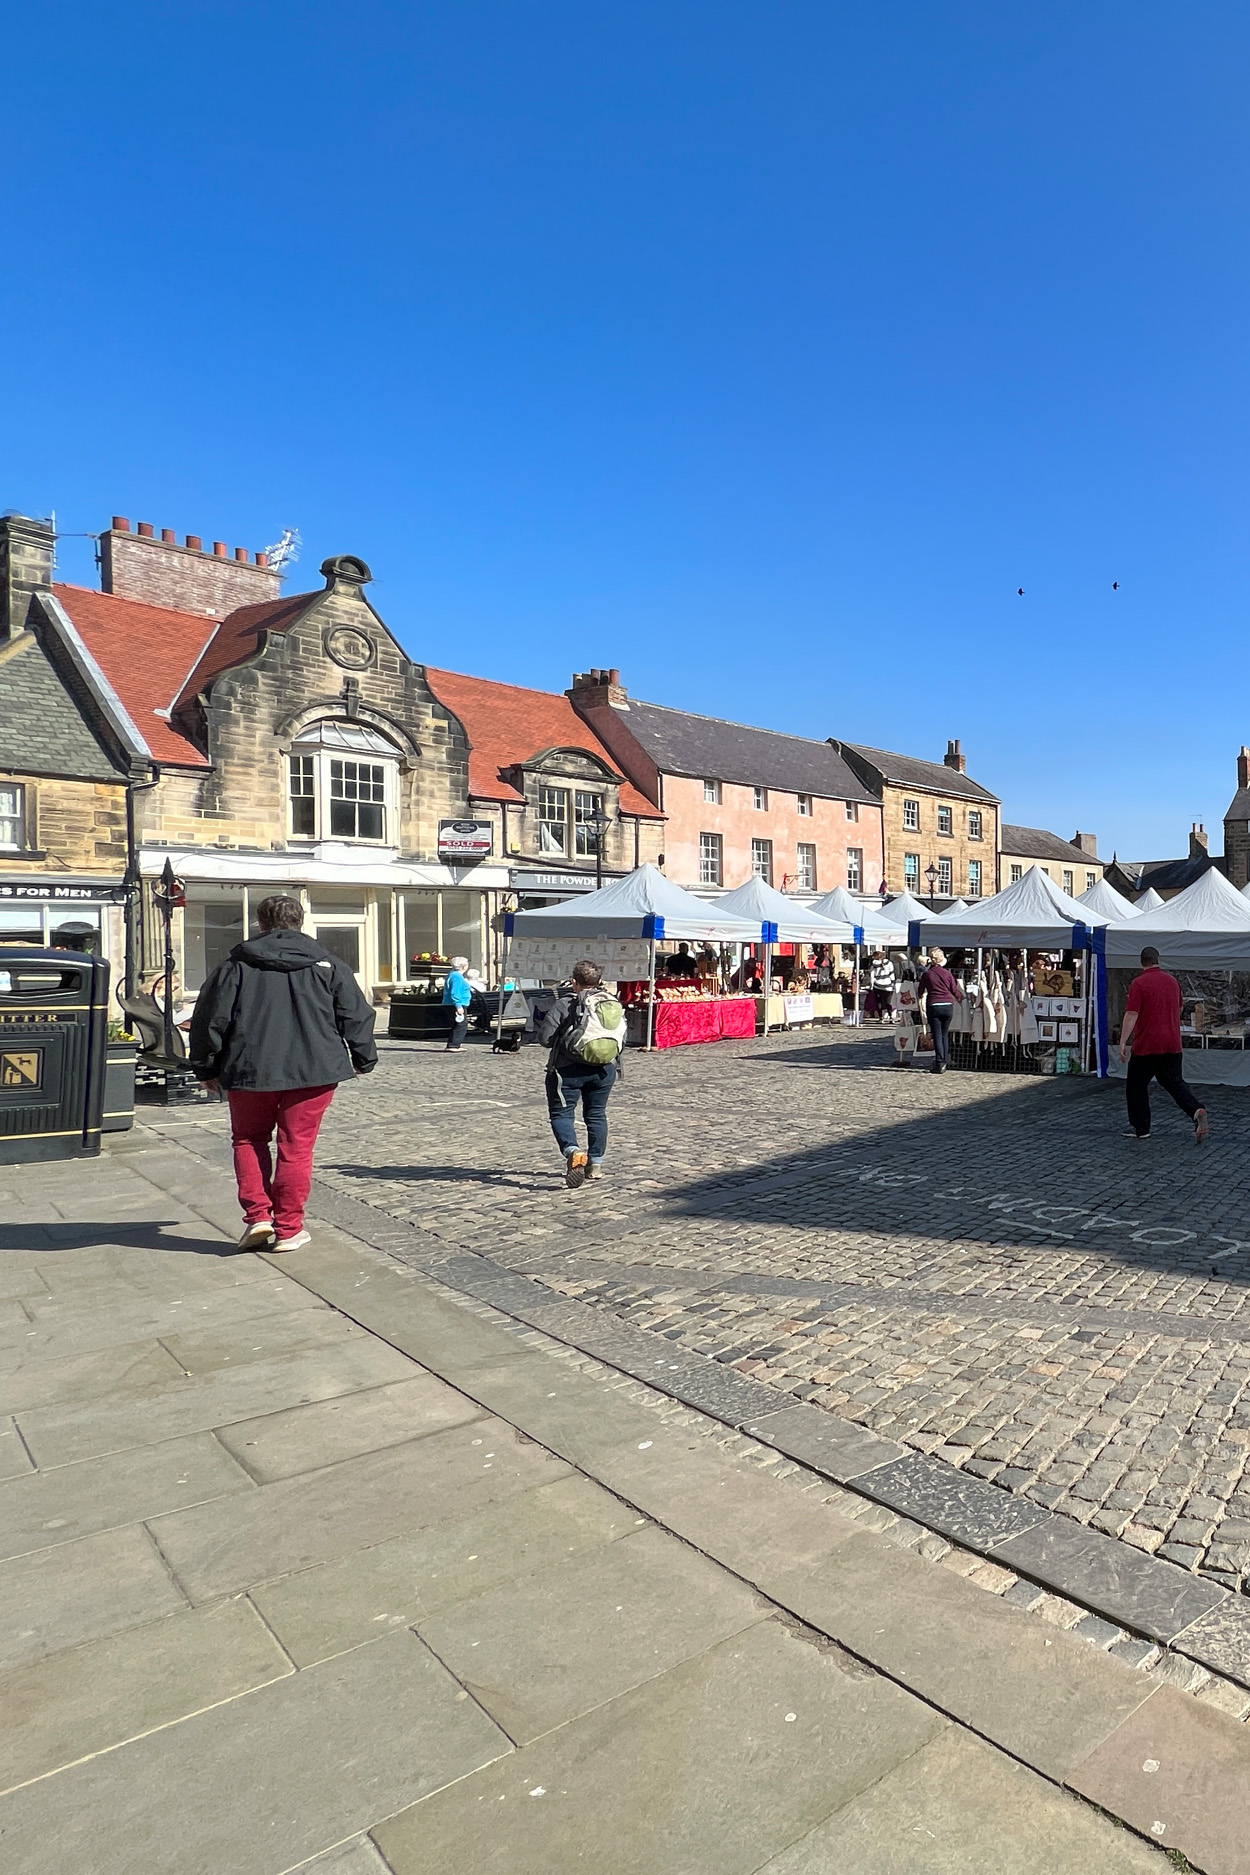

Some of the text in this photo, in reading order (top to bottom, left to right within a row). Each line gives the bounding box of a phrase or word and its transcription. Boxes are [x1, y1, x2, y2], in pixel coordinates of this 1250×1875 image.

[535, 874, 557, 884] THE
[560, 875, 603, 887] POWDE
[16, 887, 50, 897] FOR
